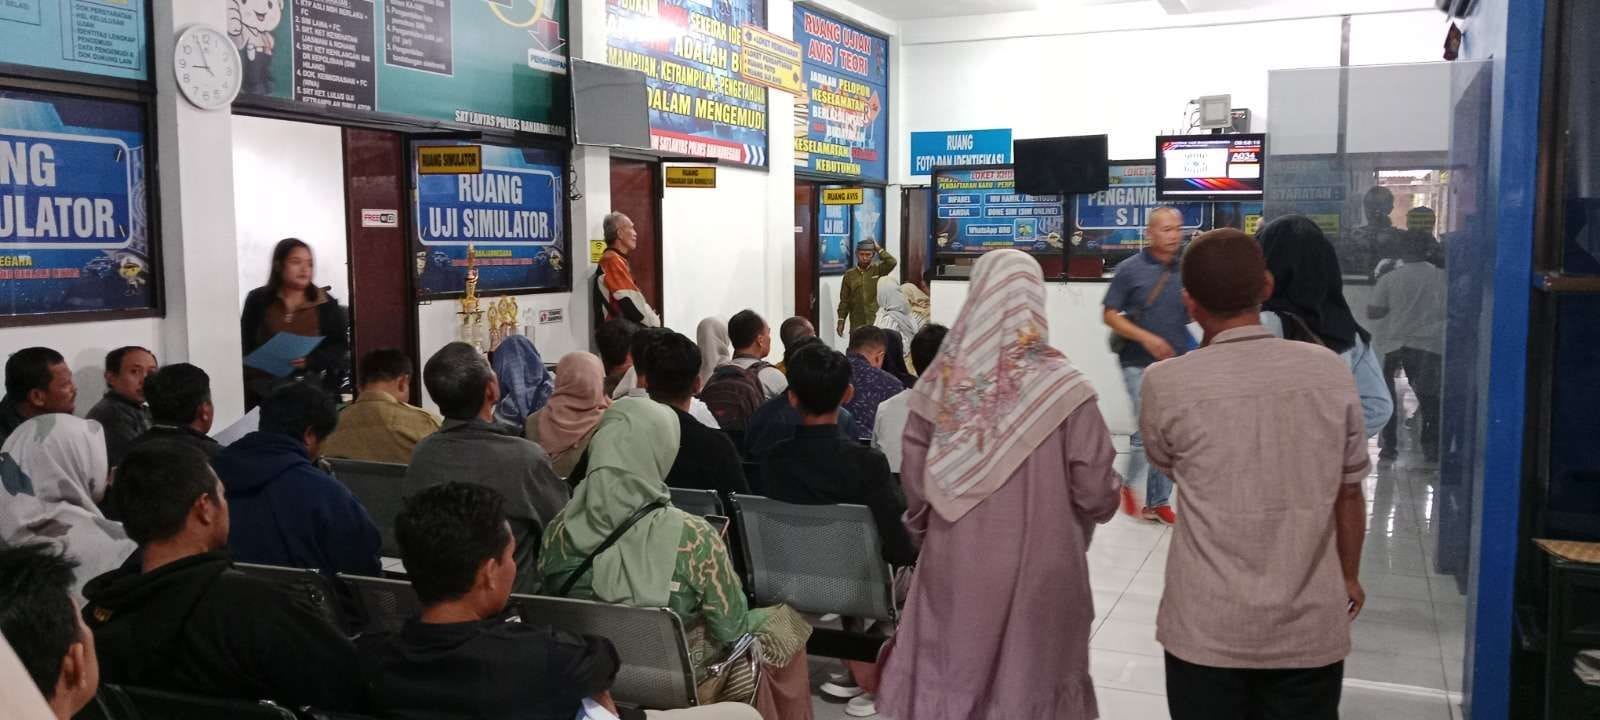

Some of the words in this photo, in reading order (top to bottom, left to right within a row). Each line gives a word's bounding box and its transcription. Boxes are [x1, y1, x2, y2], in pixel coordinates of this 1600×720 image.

[804, 13, 841, 44] RUANG
[842, 27, 871, 55] UJIAN
[673, 35, 727, 69] ADALAH
[809, 39, 833, 65] AVIS
[840, 49, 868, 76] TEORI
[838, 77, 871, 97] PELOPOR
[811, 88, 865, 113] KESELAMATAN
[455, 110, 470, 122] SAT
[471, 113, 495, 127] LANTAS
[496, 116, 520, 130] POLRES
[695, 97, 765, 130] MENGEMUDI
[794, 139, 849, 158] KESELAMATAN
[947, 134, 973, 150] RUANG
[0, 140, 56, 187] NG
[422, 154, 442, 166] RUANG
[815, 159, 861, 176] KEBUTUHAN
[916, 156, 934, 171] FOTO
[937, 156, 951, 165] DAN
[954, 154, 1005, 165] IDENTIFIKASI
[1124, 167, 1148, 176] LOKET
[459, 174, 523, 204] RUANG
[846, 192, 858, 200] AVIS
[1088, 188, 1184, 206] PENGAMB
[429, 207, 458, 237] UJI
[463, 208, 549, 238] SIMULATOR
